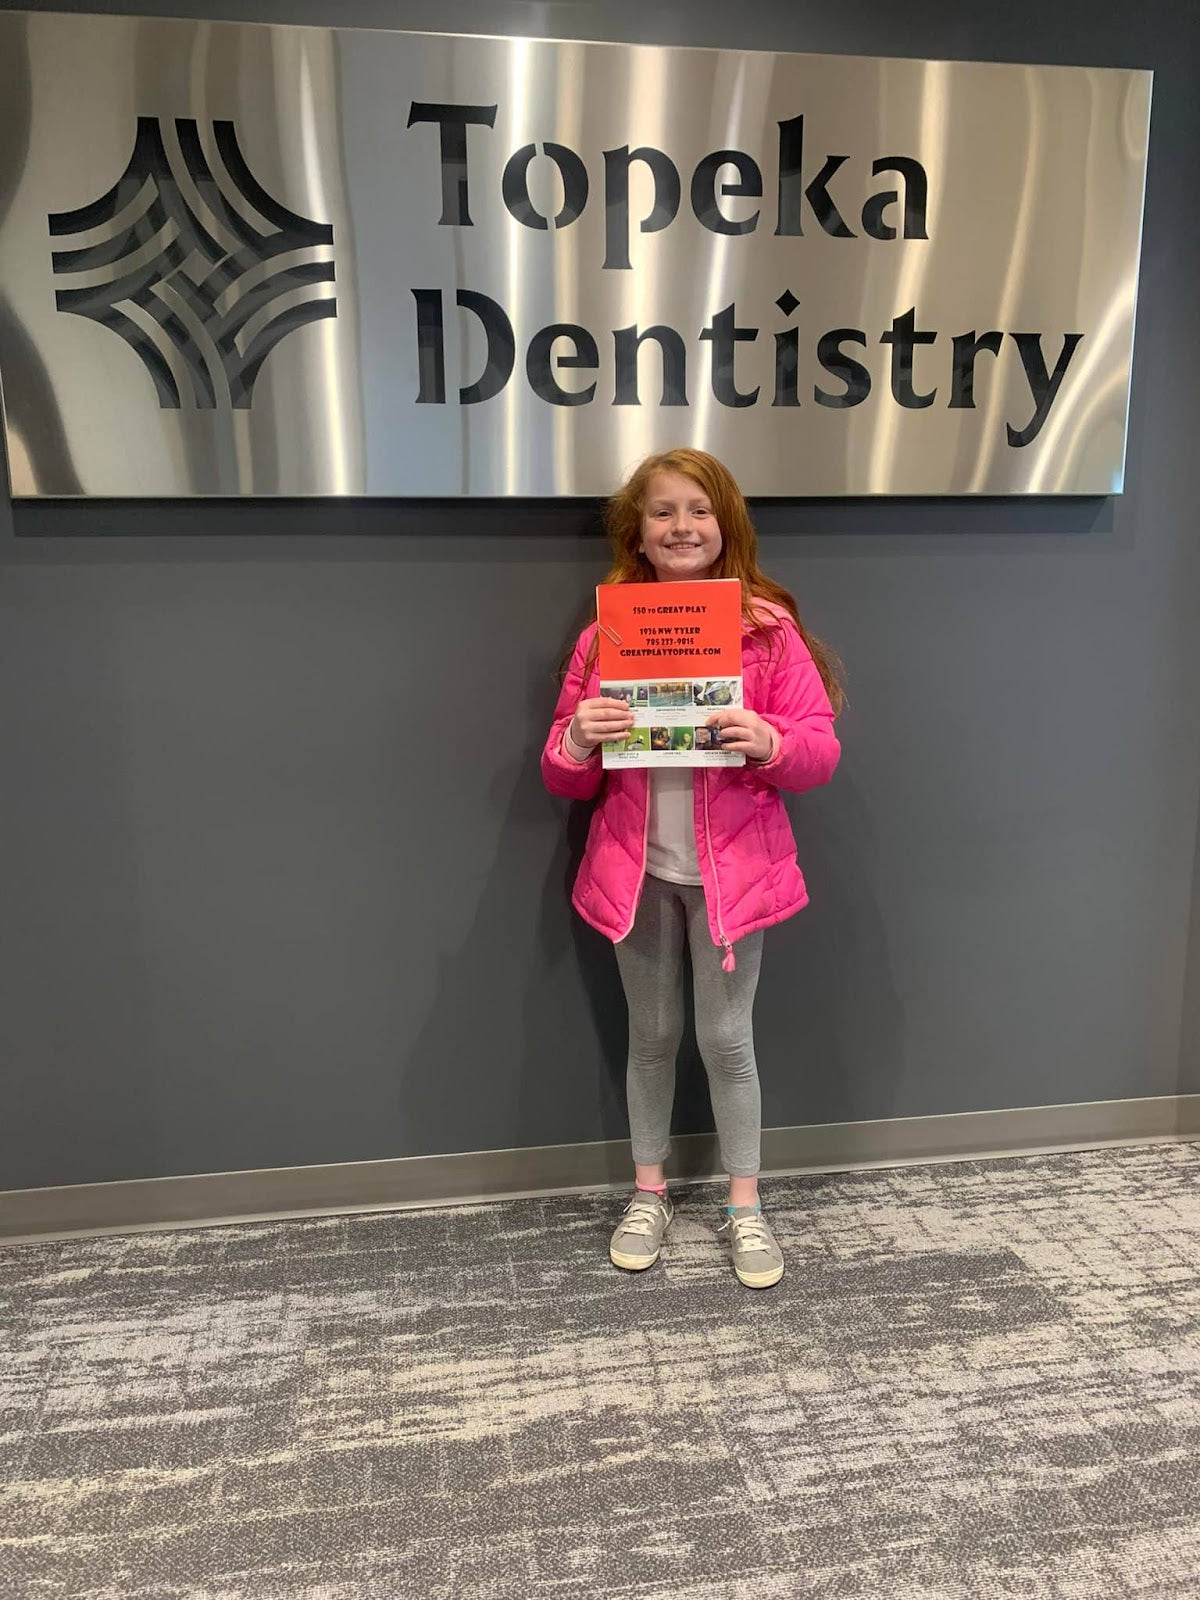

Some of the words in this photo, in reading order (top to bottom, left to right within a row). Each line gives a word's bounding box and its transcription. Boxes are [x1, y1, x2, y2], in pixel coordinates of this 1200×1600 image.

[407, 101, 929, 270] Topeka
[410, 288, 1085, 448] Dentistry
[656, 606, 684, 614] GREAT
[685, 605, 707, 613] PLAY
[658, 627, 673, 635] NW
[674, 627, 701, 635] TYLER
[646, 638, 660, 646] 785
[620, 648, 721, 657] GREATPLAYTOPEKA.COM
